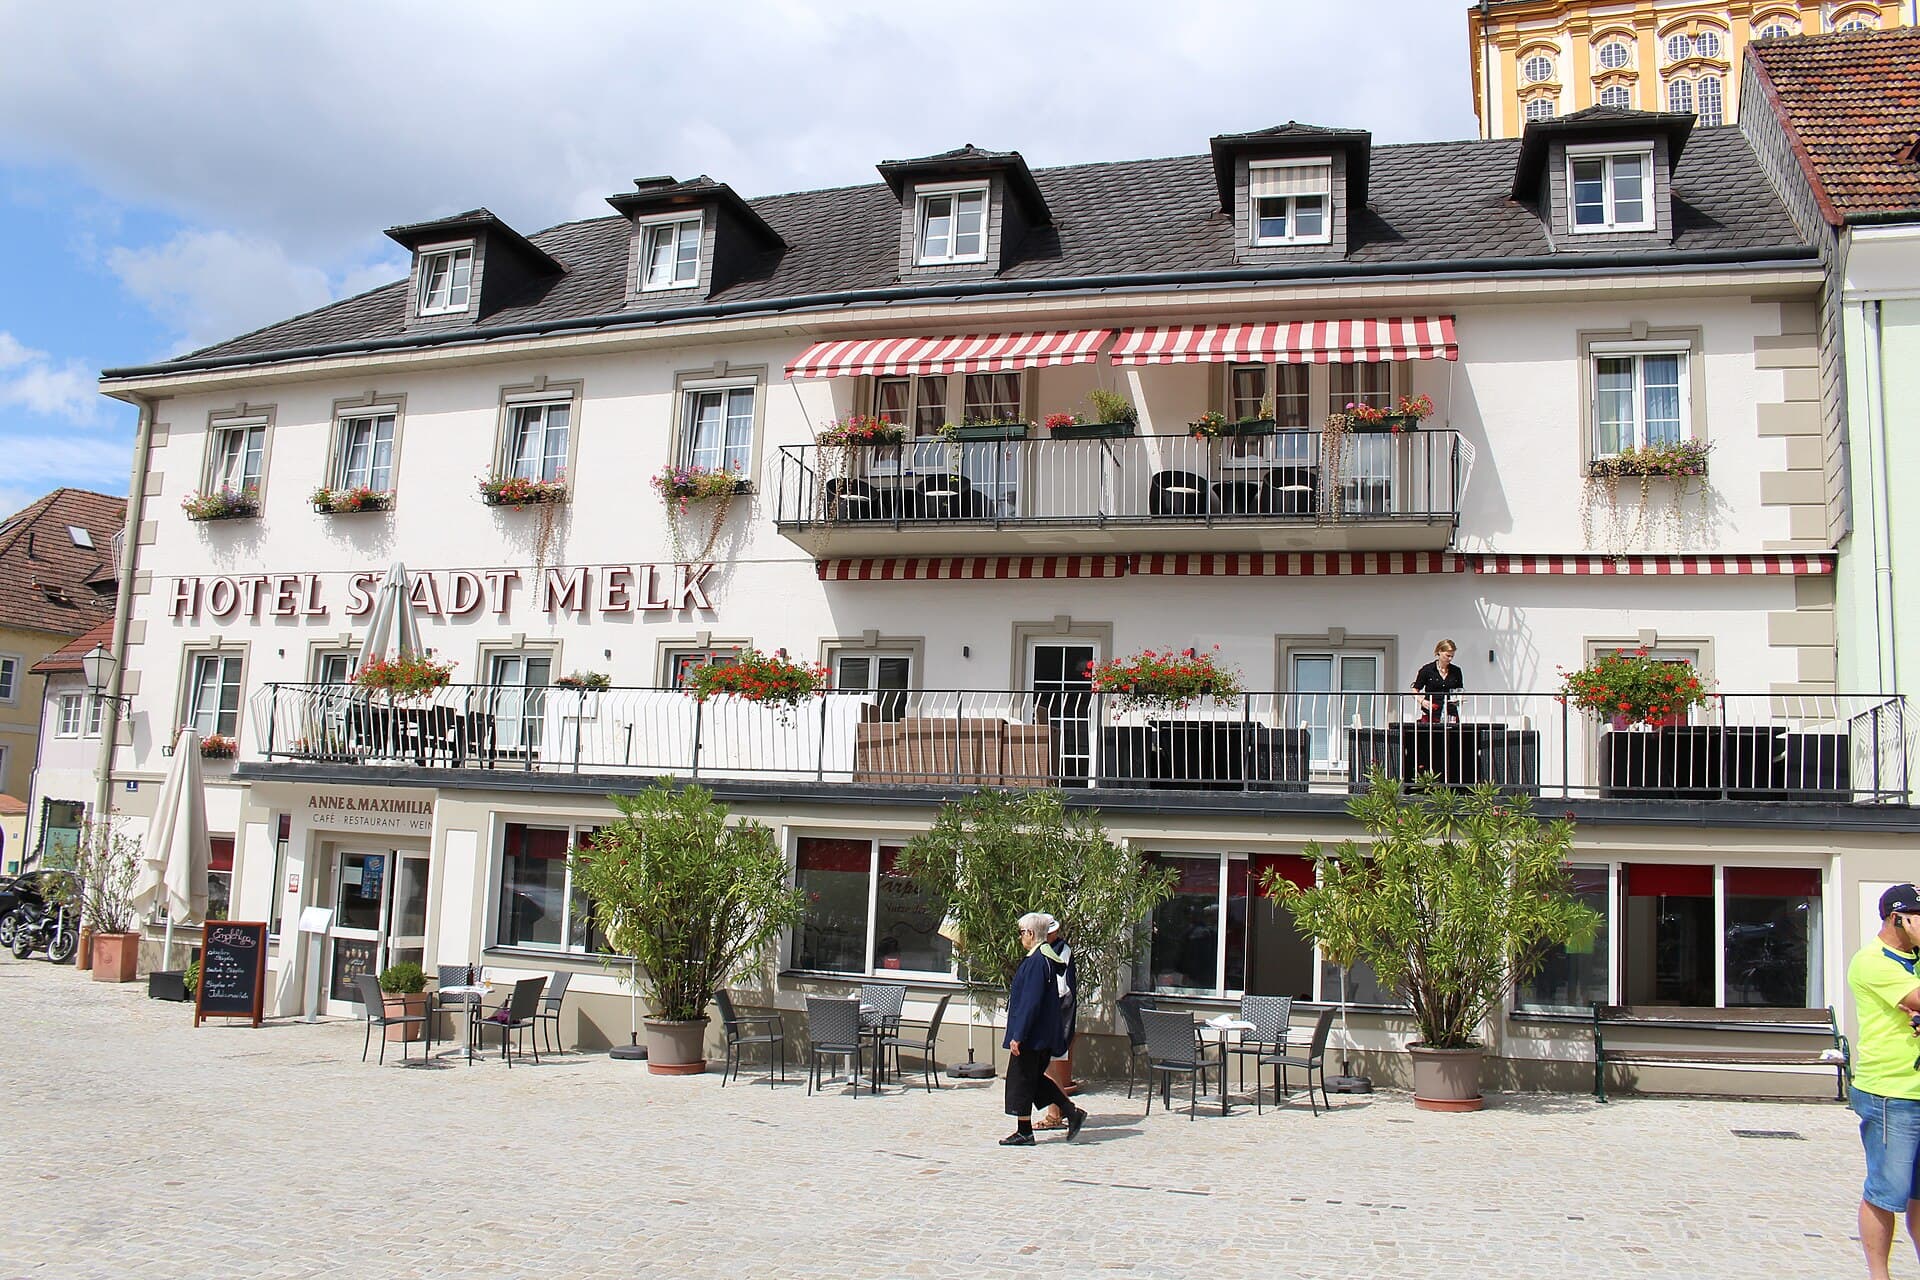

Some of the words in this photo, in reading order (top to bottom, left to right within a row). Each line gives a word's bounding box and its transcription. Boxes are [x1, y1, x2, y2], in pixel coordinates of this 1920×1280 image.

[168, 574, 328, 617] HOTEL
[345, 570, 519, 616] SADT
[542, 563, 715, 613] MELK
[344, 815, 401, 828] RESTAURANT
